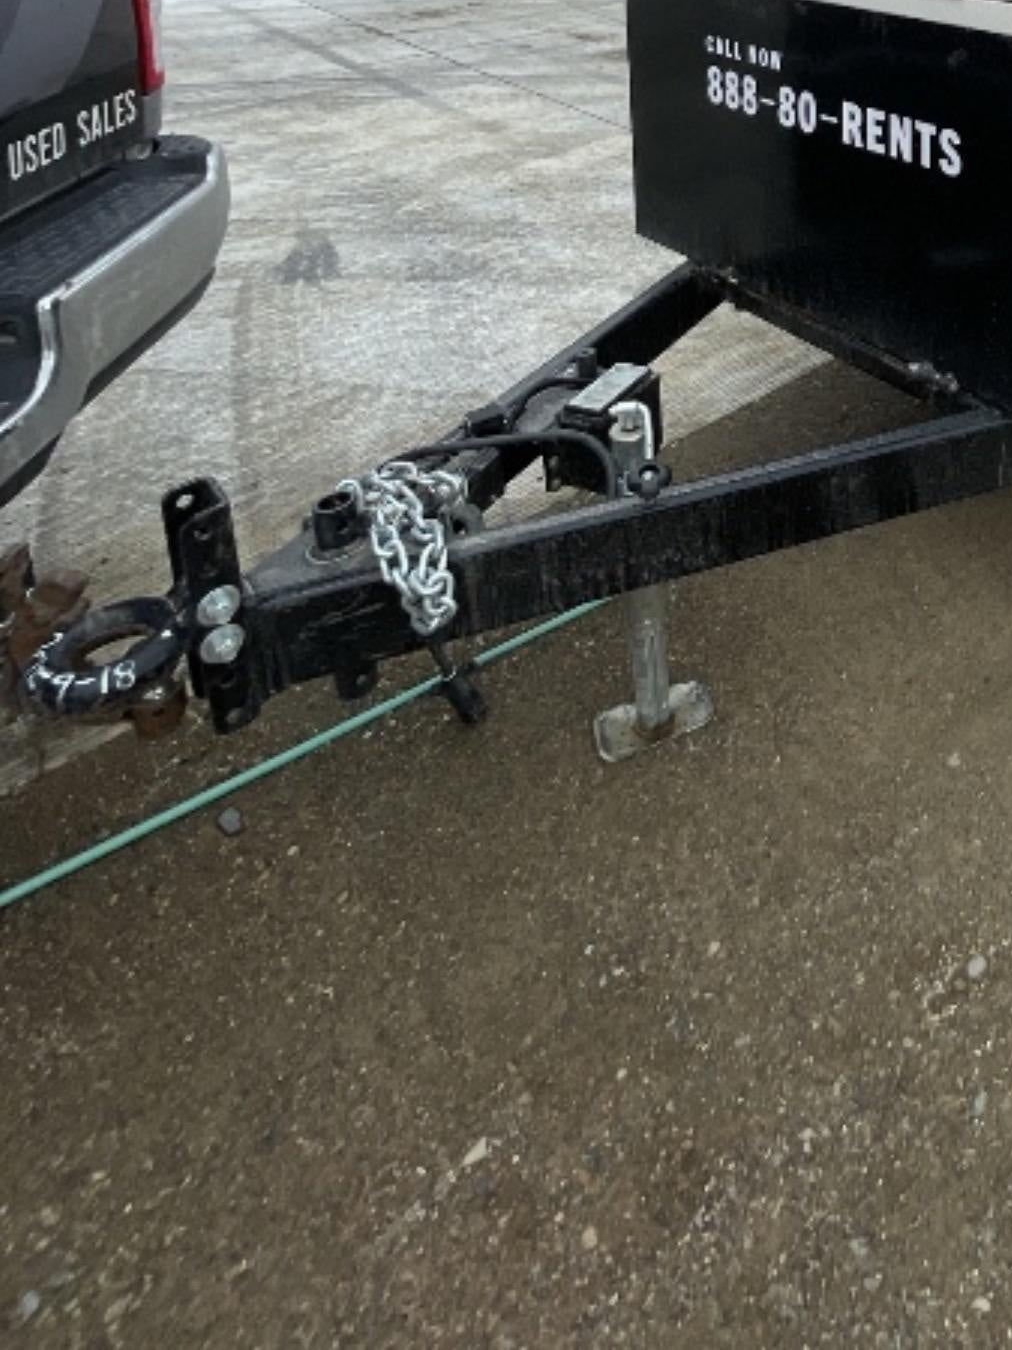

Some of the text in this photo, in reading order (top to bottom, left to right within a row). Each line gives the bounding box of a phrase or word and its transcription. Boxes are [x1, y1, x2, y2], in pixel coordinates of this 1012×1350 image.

[705, 35, 784, 71] CALL NOW
[7, 88, 136, 181] USED SALES
[706, 64, 963, 178] 888-80-RENTS
